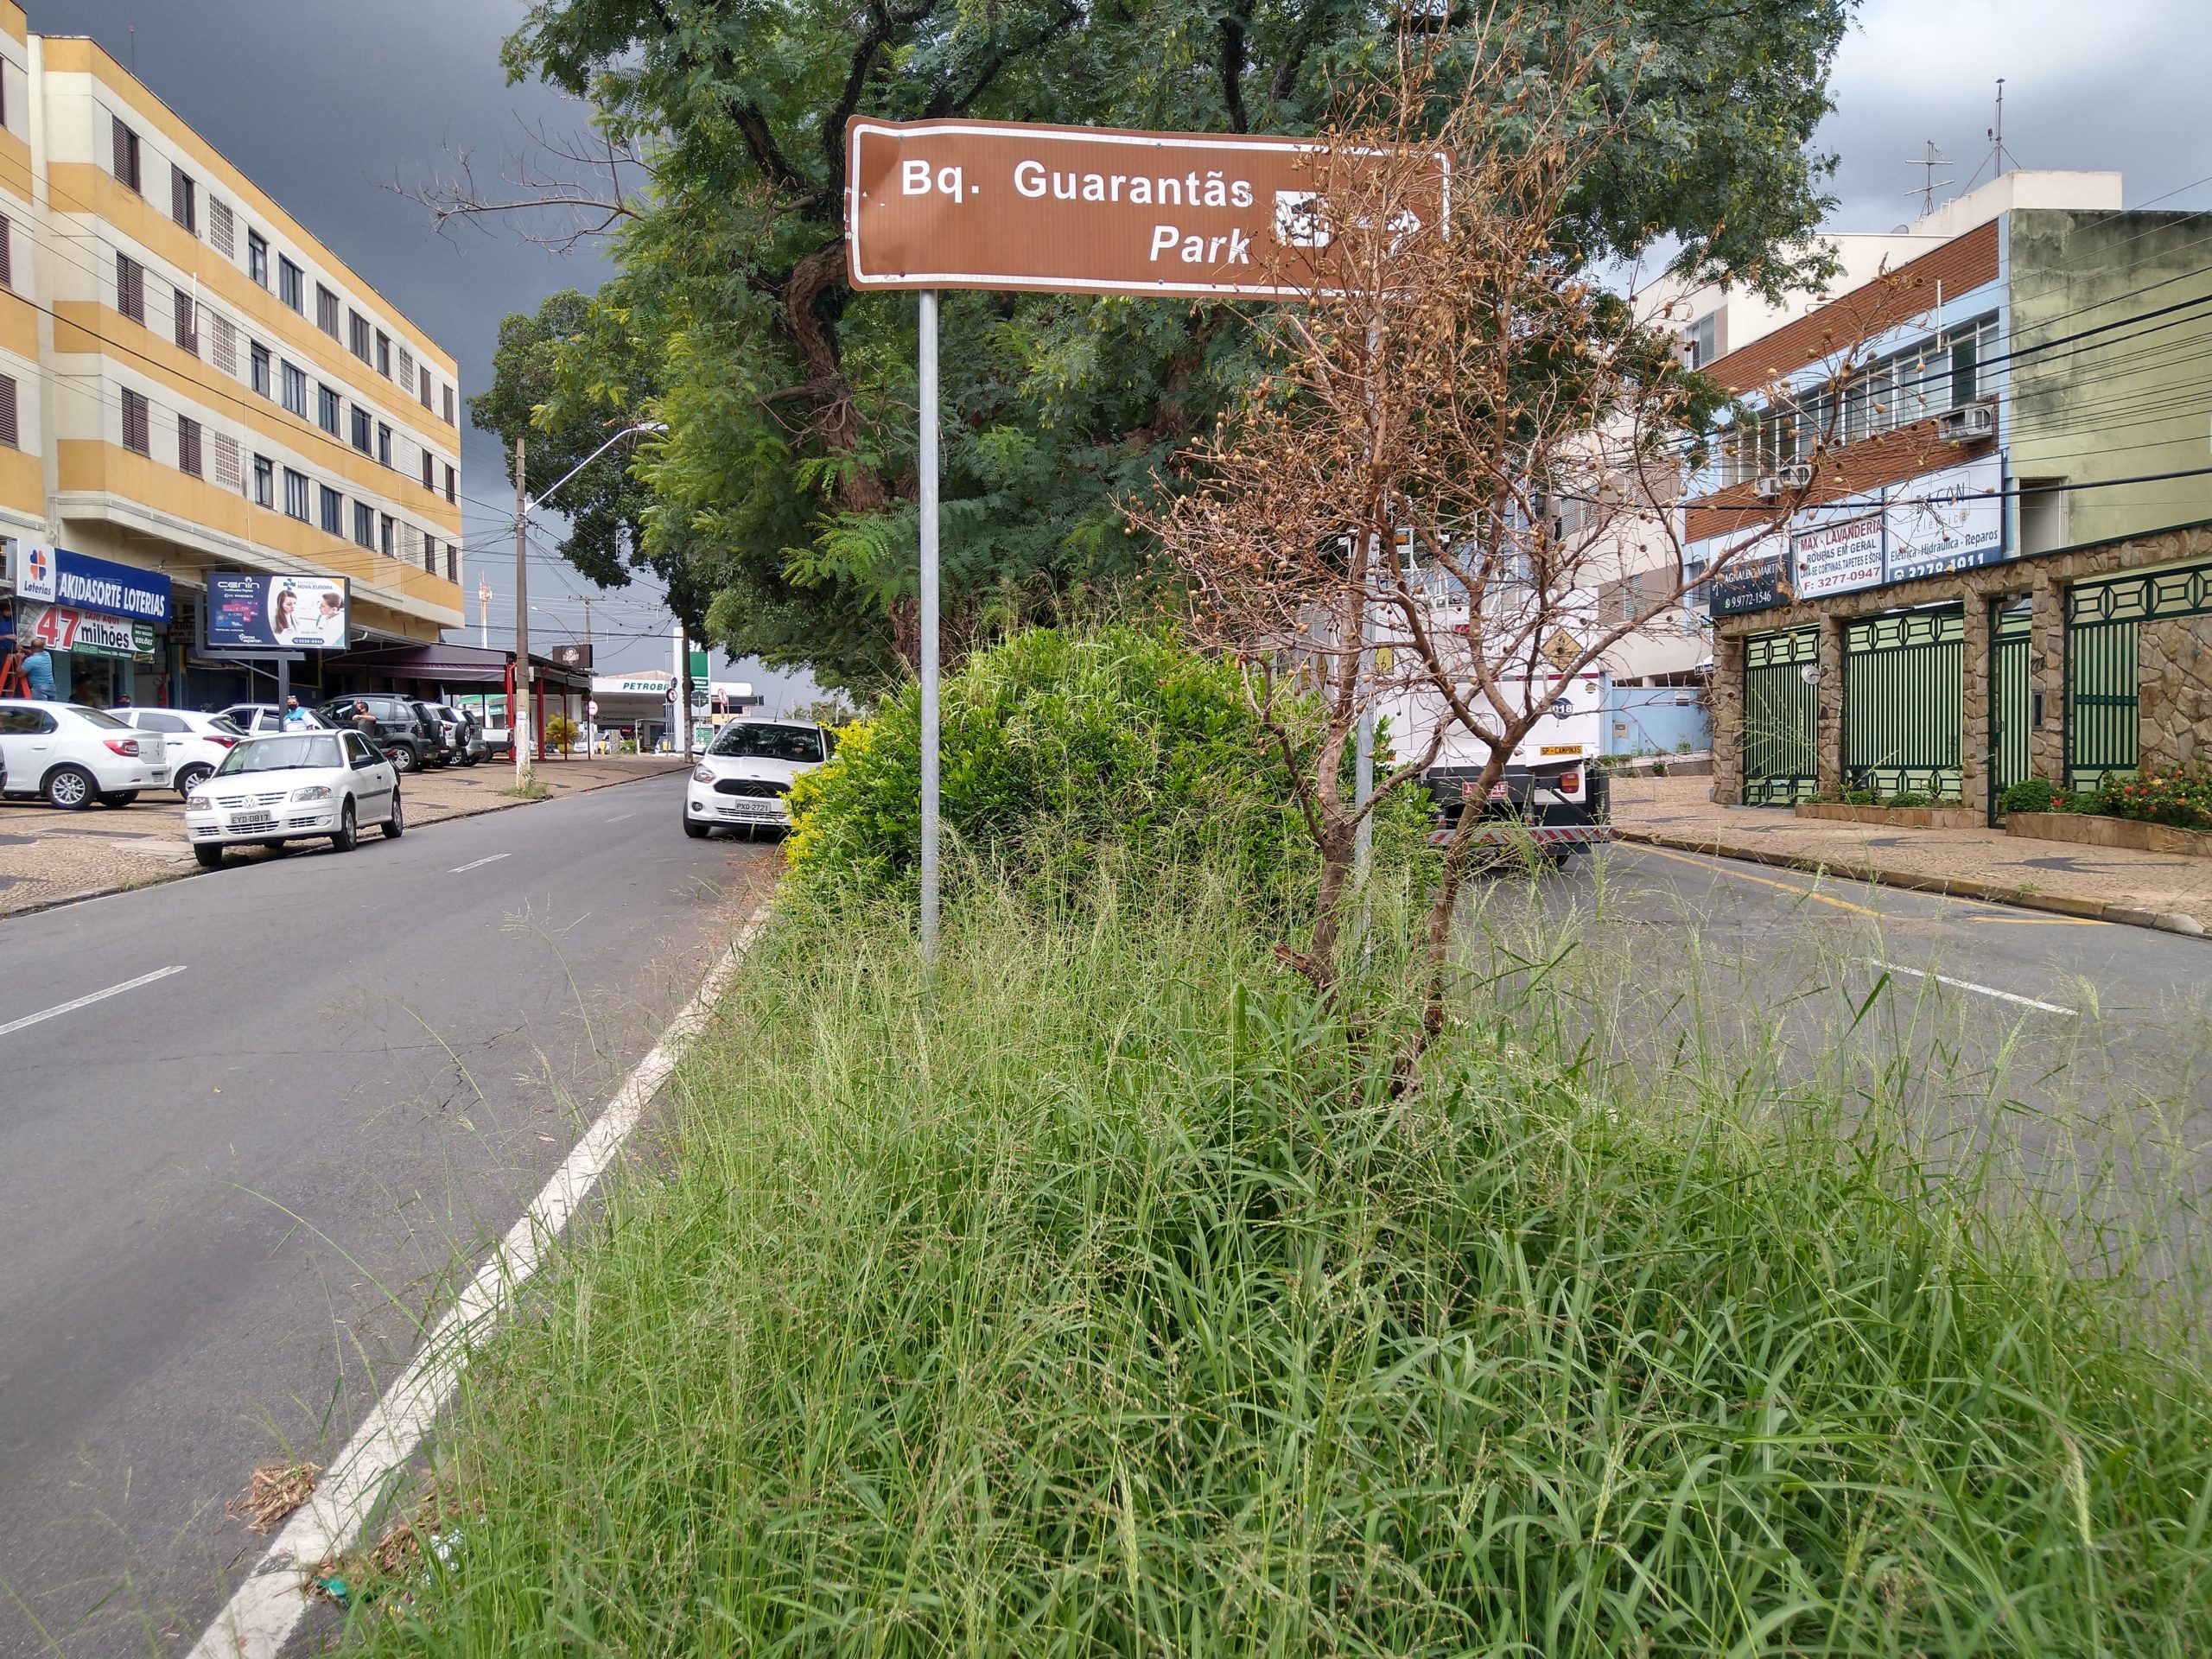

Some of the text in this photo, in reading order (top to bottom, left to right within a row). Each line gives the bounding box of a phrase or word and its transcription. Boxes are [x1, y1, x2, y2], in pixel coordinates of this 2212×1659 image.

[902, 159, 1253, 208] Bq. Guarantãs
[1150, 225, 1250, 264] Park
[1800, 519, 1883, 552] MAX LAVANDERIA
[1965, 530, 1999, 546] Reparos
[1807, 538, 1877, 564] ROUPAS EM GERAL
[1843, 555, 1864, 569] TAPETES
[1865, 554, 1868, 565] E
[24, 581, 52, 596] Loterias
[1804, 567, 1881, 591] F: 3277-0947
[59, 573, 166, 617] AKIDASORTE LOTERIAS
[36, 607, 130, 650] 47 milhões
[102, 615, 119, 626] AQUI
